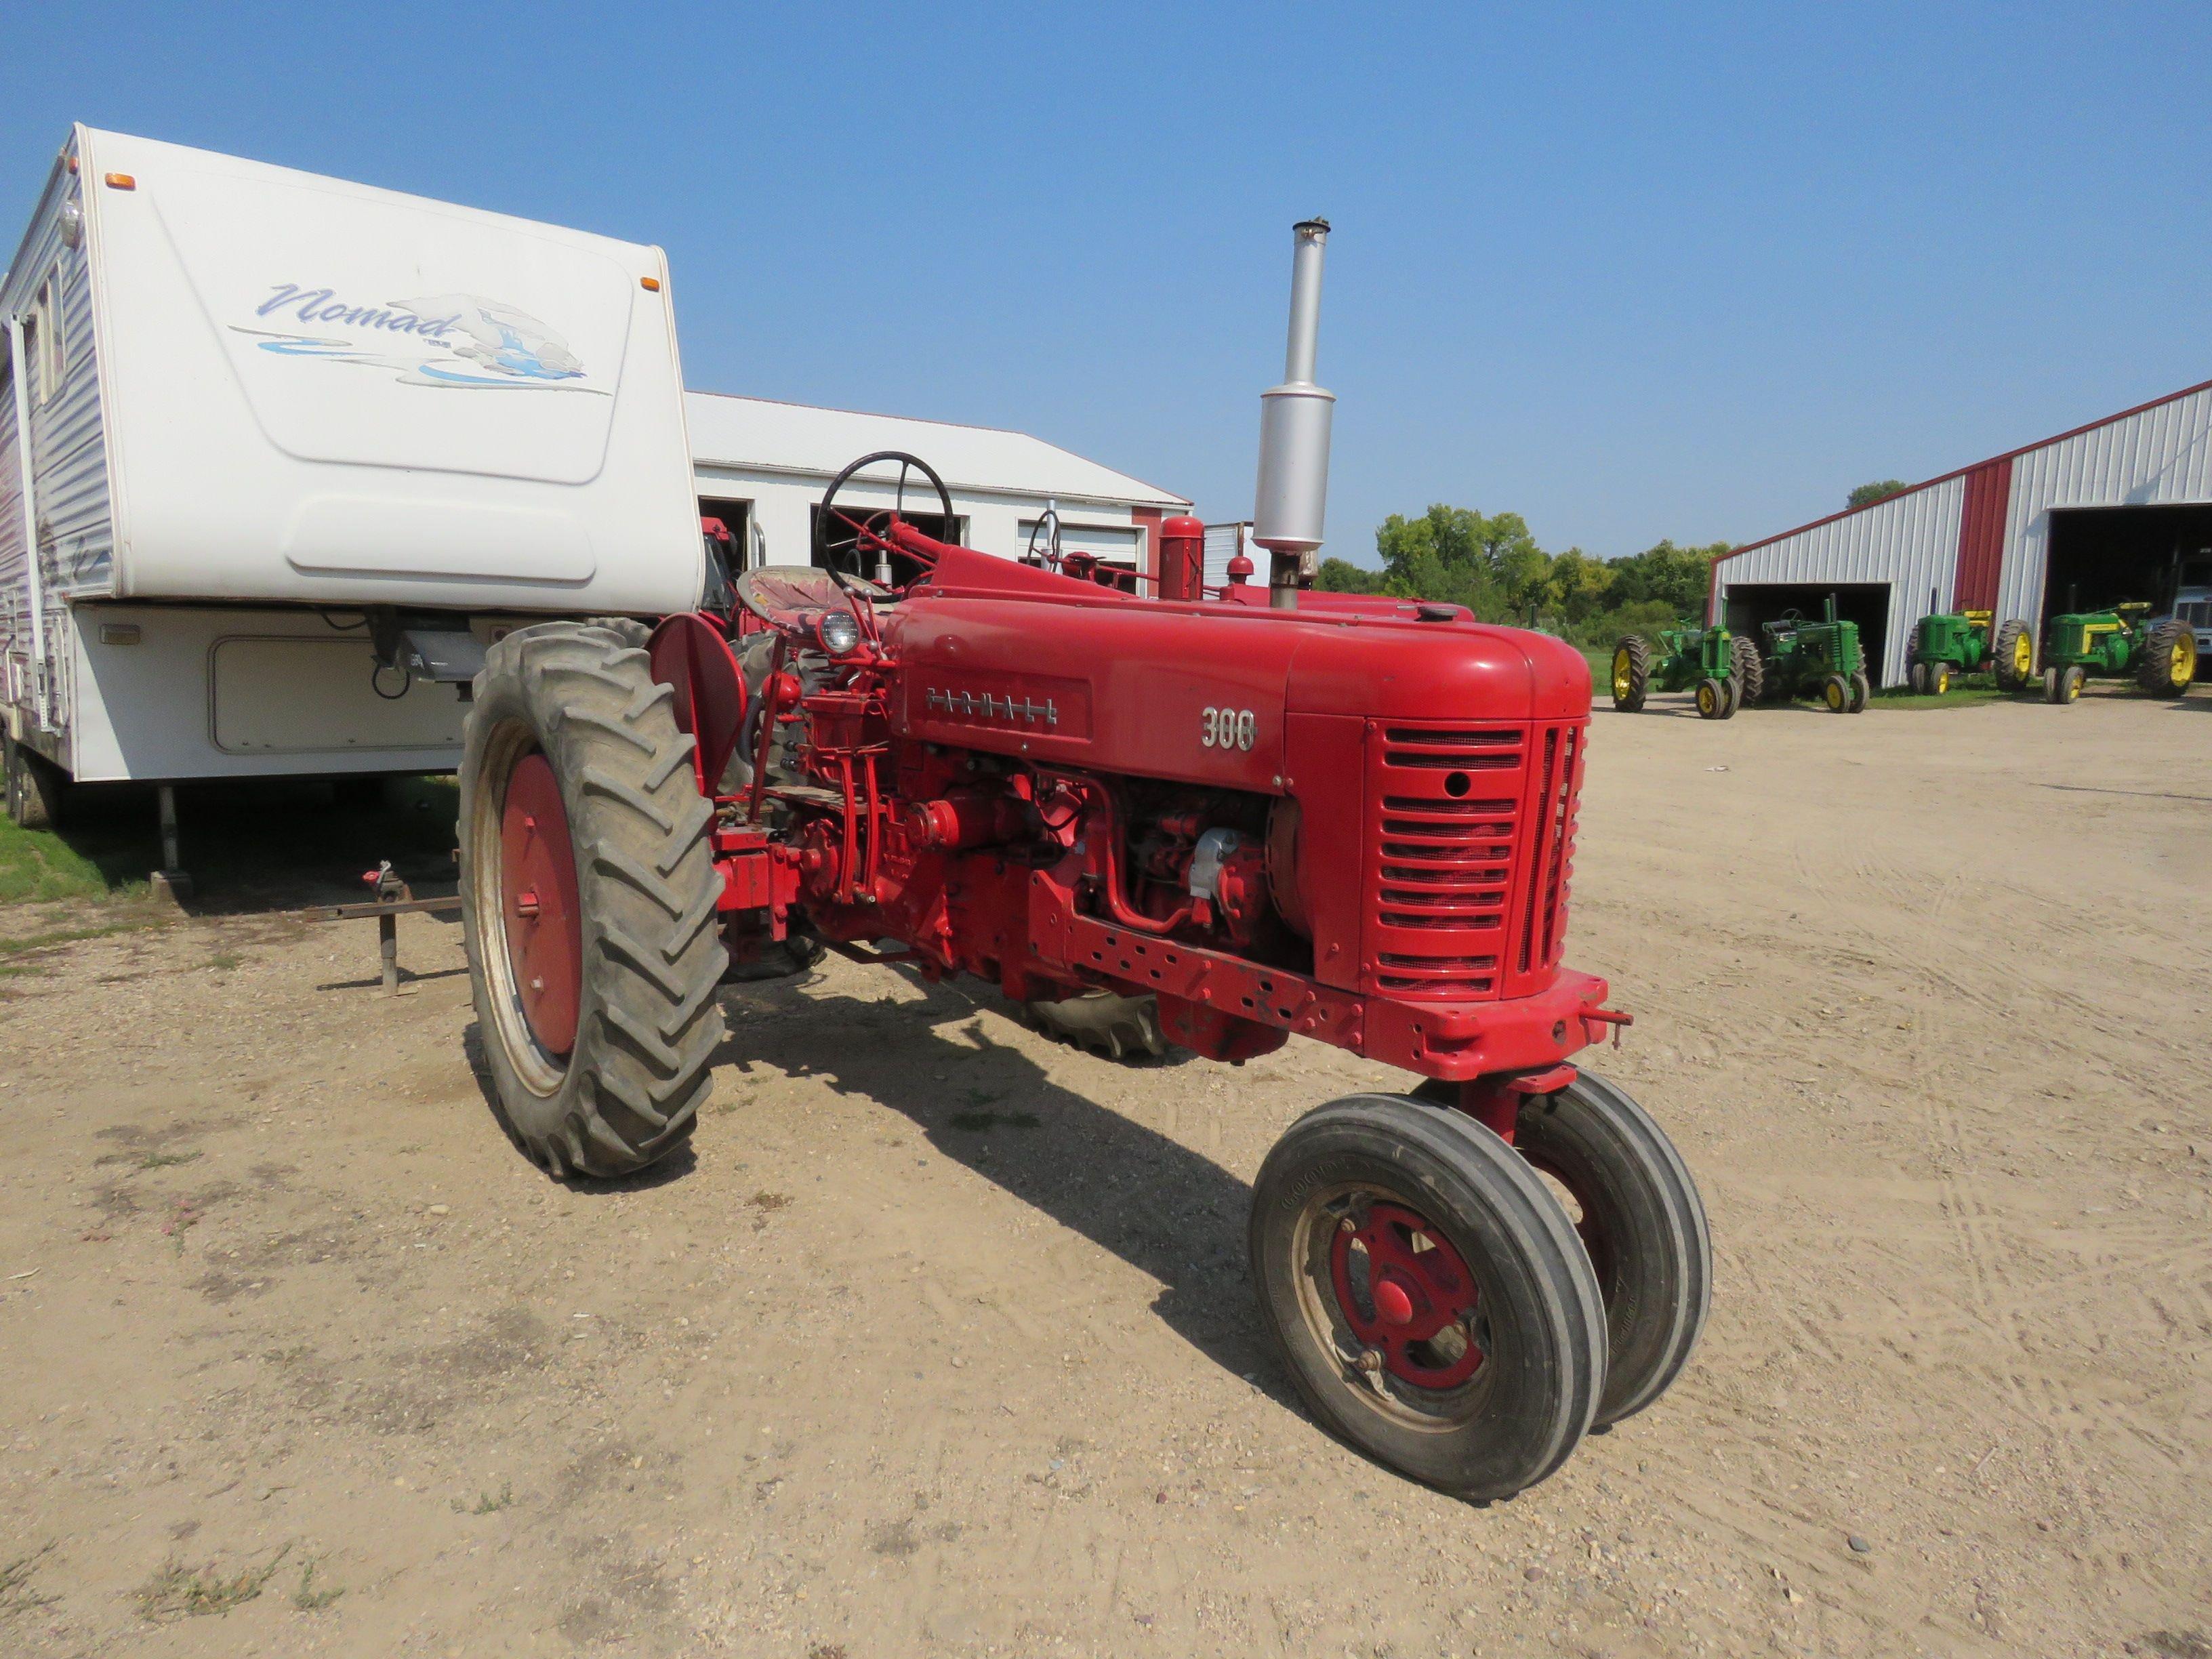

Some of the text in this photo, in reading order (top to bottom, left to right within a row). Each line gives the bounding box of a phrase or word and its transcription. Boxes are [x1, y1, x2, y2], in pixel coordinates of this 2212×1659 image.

[255, 282, 463, 337] Nomad
[926, 687, 1057, 725] FARMALL
[1201, 706, 1256, 752] 300
